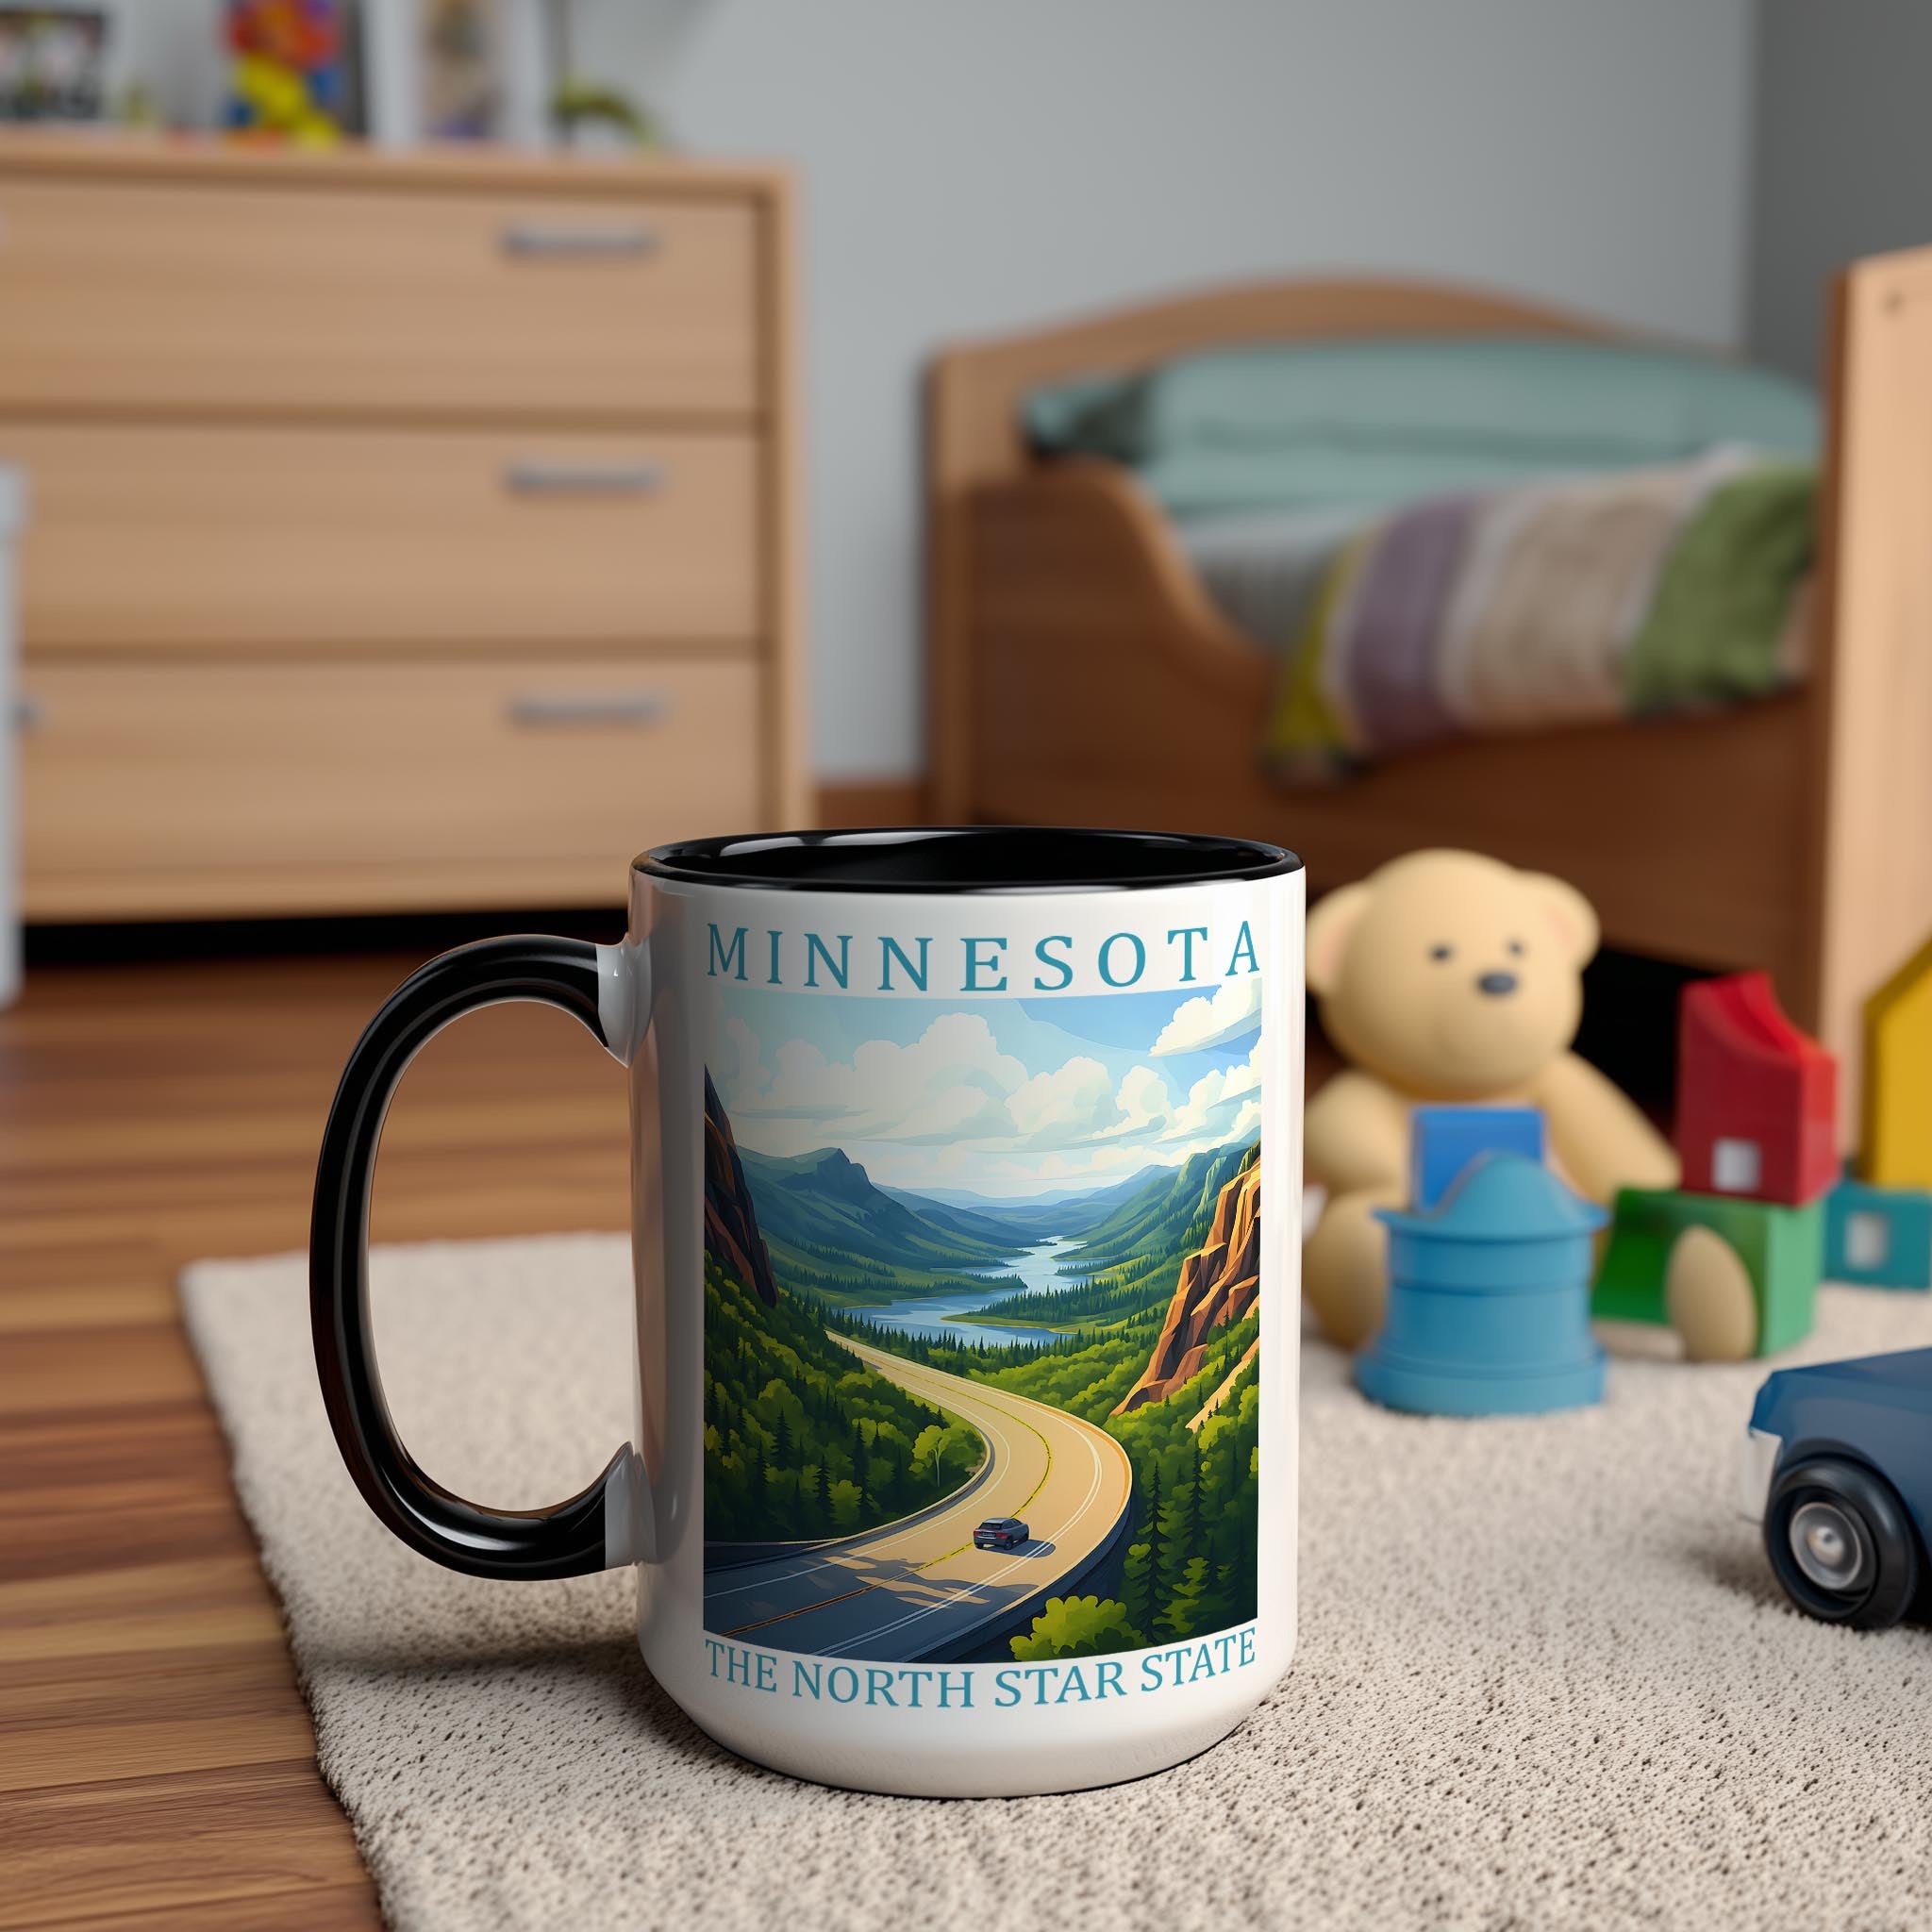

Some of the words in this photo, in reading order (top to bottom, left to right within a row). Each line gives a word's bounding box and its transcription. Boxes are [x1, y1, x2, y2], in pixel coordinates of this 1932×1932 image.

[708, 921, 1260, 992] MINNESOTA
[705, 1639, 777, 1692] THE
[792, 1660, 974, 1708] NORTH
[994, 1661, 1126, 1707] STAR
[1141, 1626, 1256, 1692] STATE
